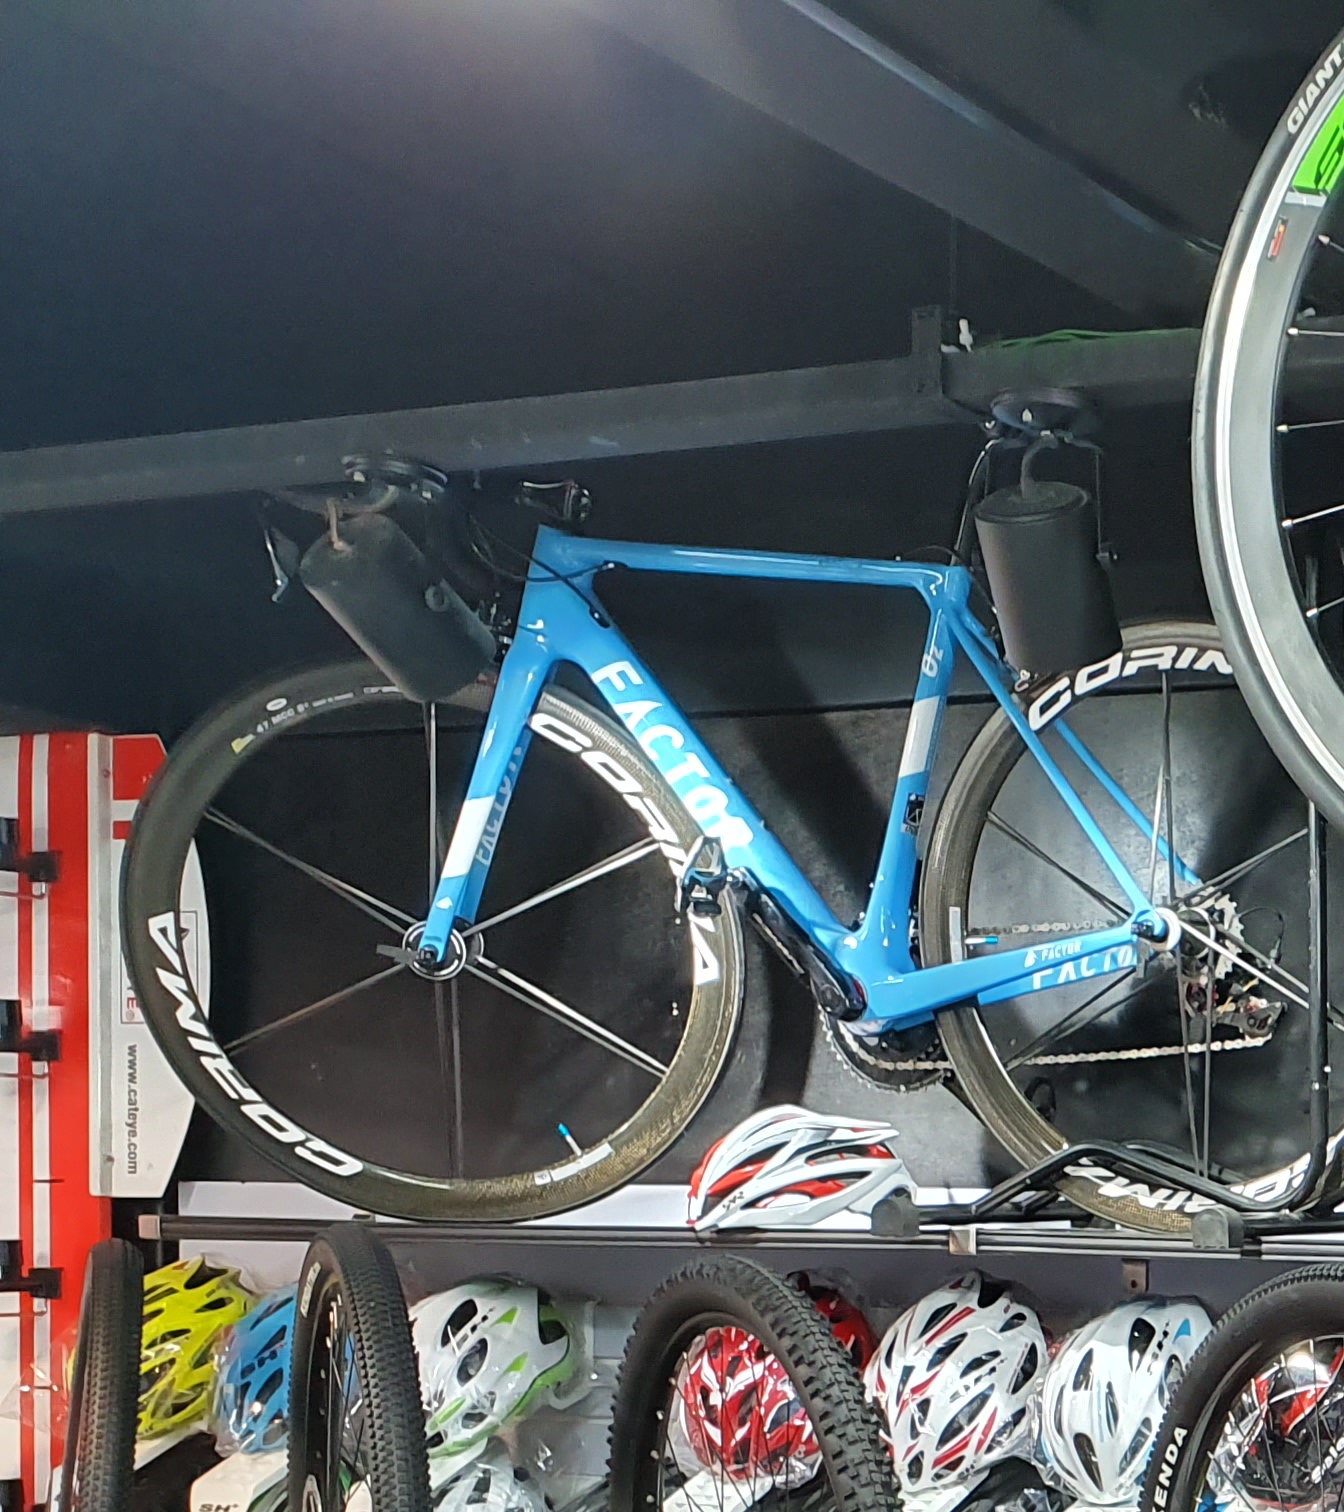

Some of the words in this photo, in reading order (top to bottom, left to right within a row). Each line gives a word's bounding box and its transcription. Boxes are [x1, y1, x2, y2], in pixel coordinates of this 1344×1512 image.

[1286, 43, 1343, 134] GIANT
[1028, 645, 1234, 731] CORIM
[591, 661, 754, 848] FACTOR
[1032, 944, 1137, 990] FACTO
[147, 910, 364, 1177] CORIMA
[125, 1044, 139, 1175] www.cateye.com
